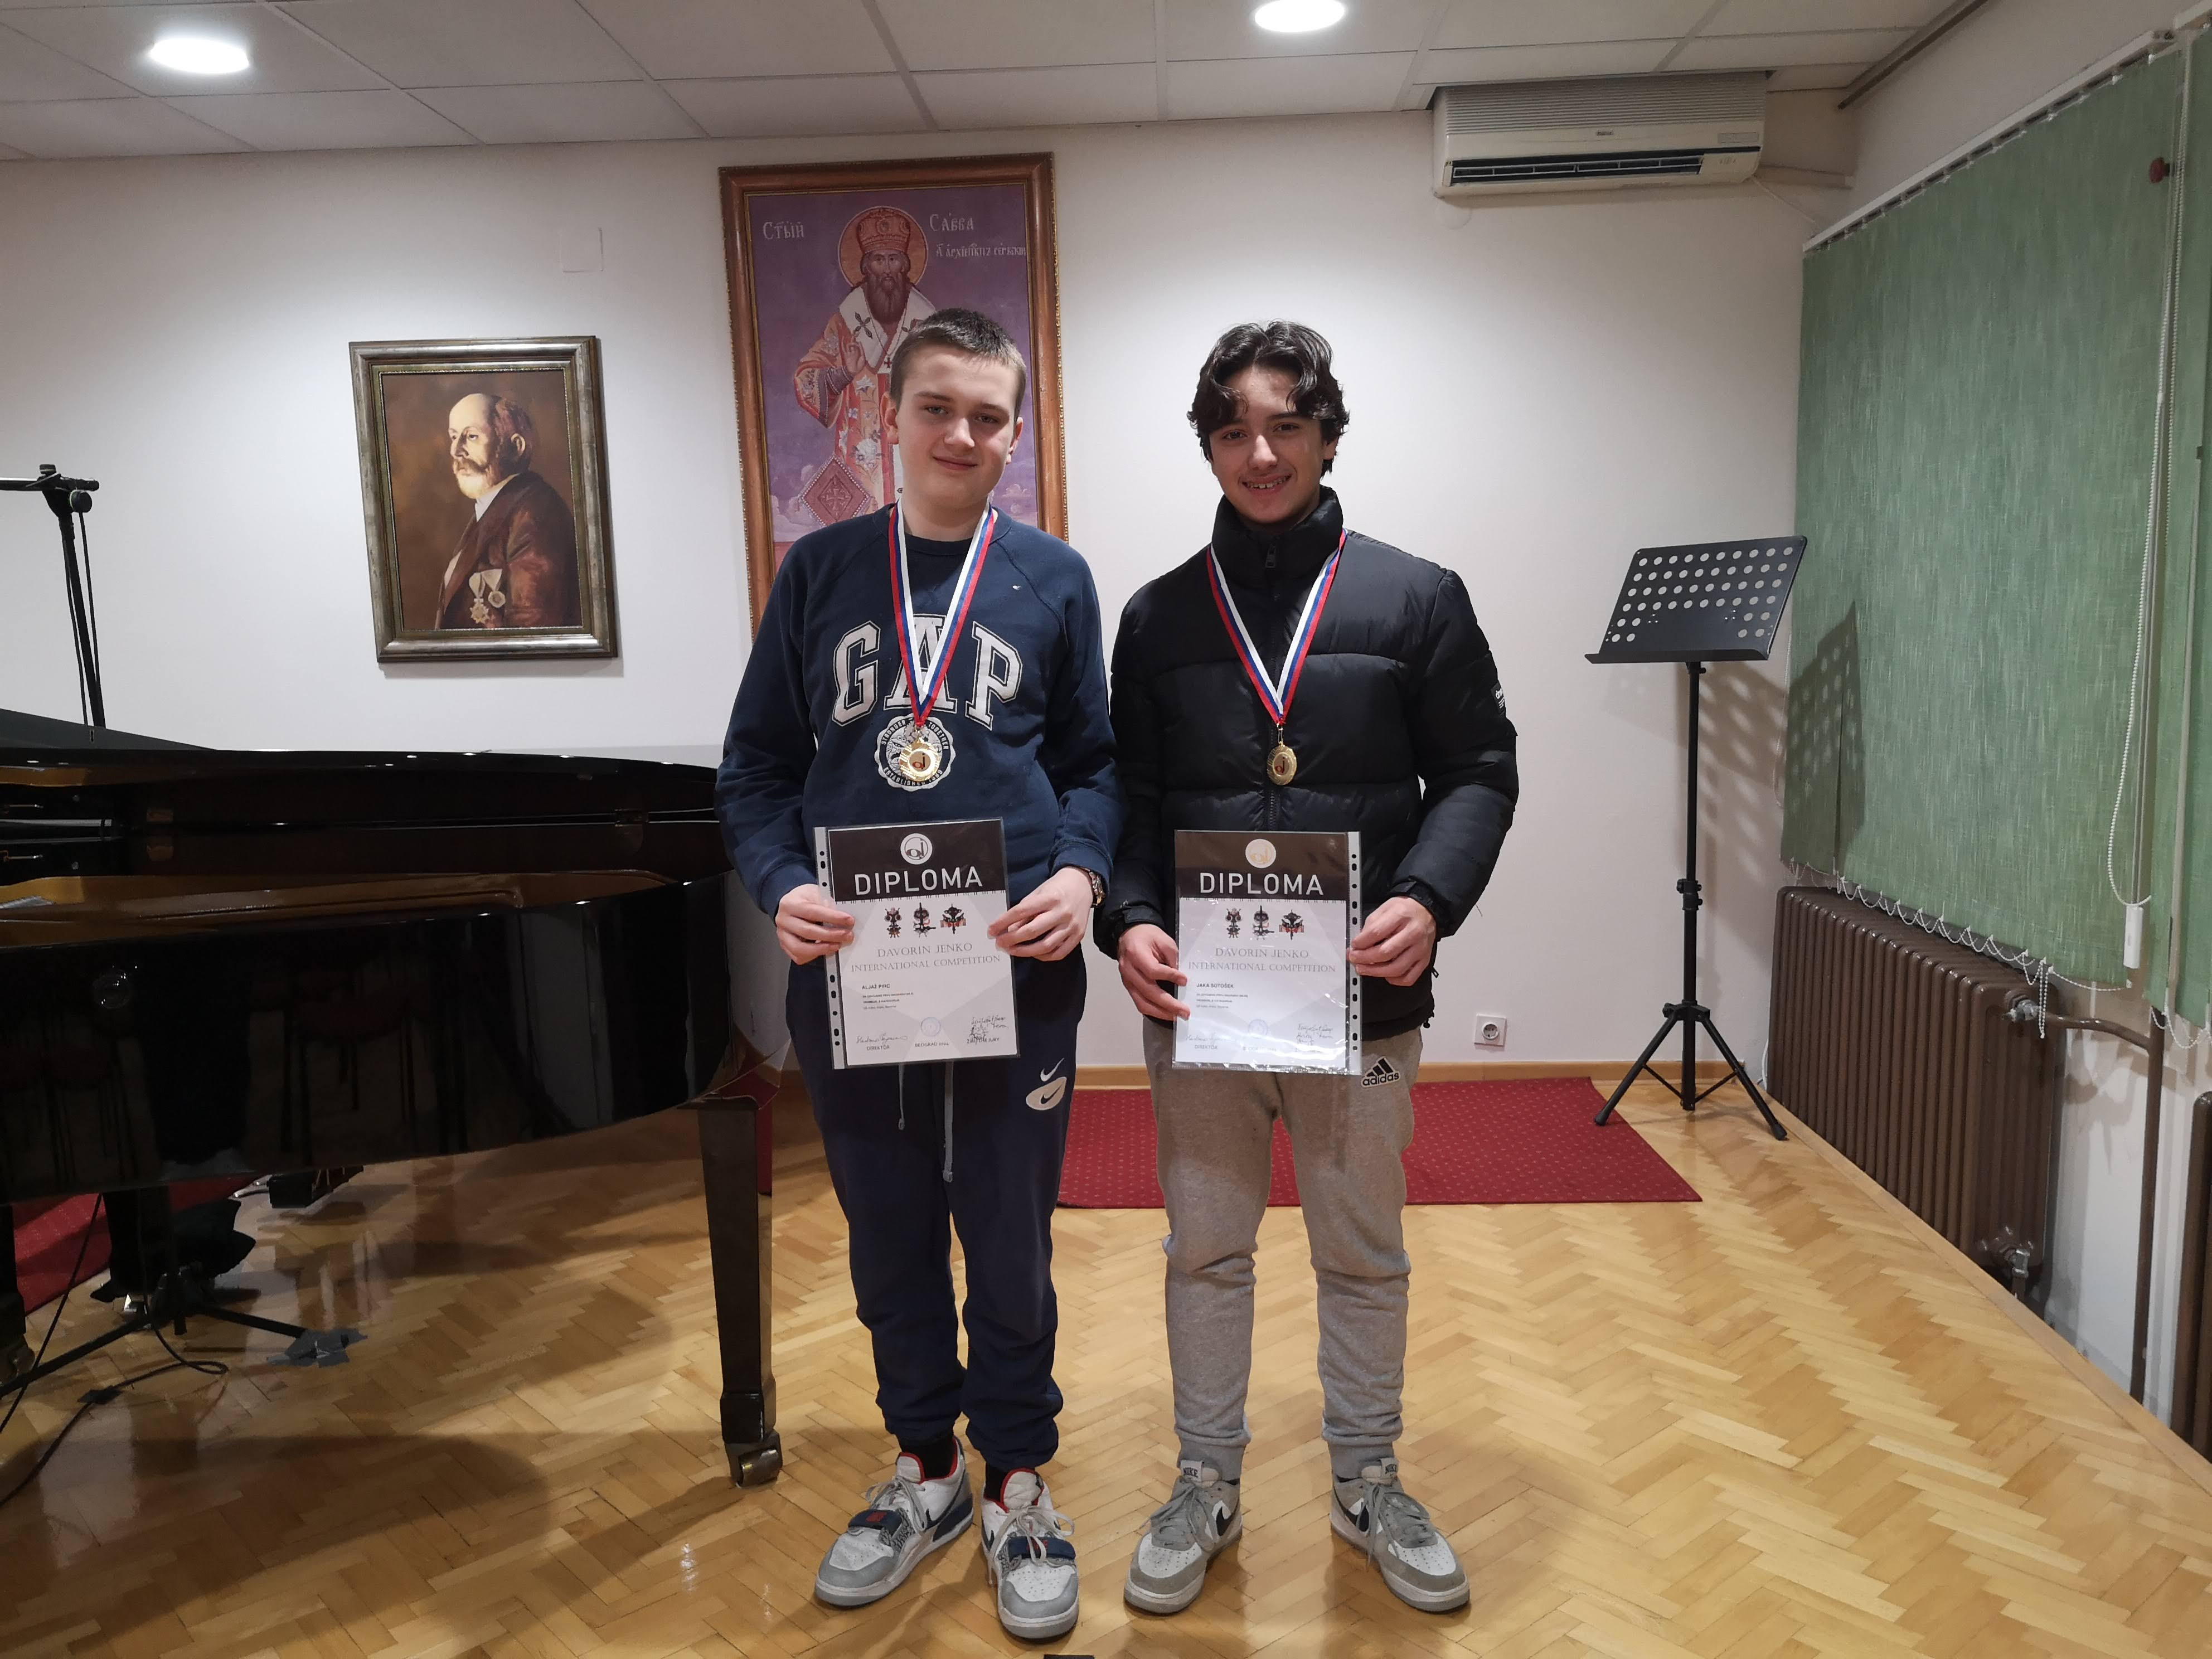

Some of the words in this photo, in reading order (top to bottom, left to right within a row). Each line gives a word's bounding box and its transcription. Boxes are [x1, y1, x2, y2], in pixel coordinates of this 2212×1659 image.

[832, 613, 1022, 730] GAP
[928, 722, 949, 750] TOGETHER
[855, 866, 983, 896] DIPLOMA
[1200, 872, 1324, 895] DIPLOMA
[877, 945, 931, 957] DAVORIN
[935, 943, 973, 954] JENKO
[1216, 948, 1267, 957] DAVORIN
[1271, 949, 1309, 958] JENKO
[851, 959, 930, 972] INTERNATIONAL
[934, 955, 1001, 967] COMPETITION
[1188, 962, 1266, 971] INTERNATIONAL
[1269, 963, 1336, 973] COMPETITION
[1362, 1073, 1399, 1086] adidas
[1183, 1467, 1198, 1478] NIKE
